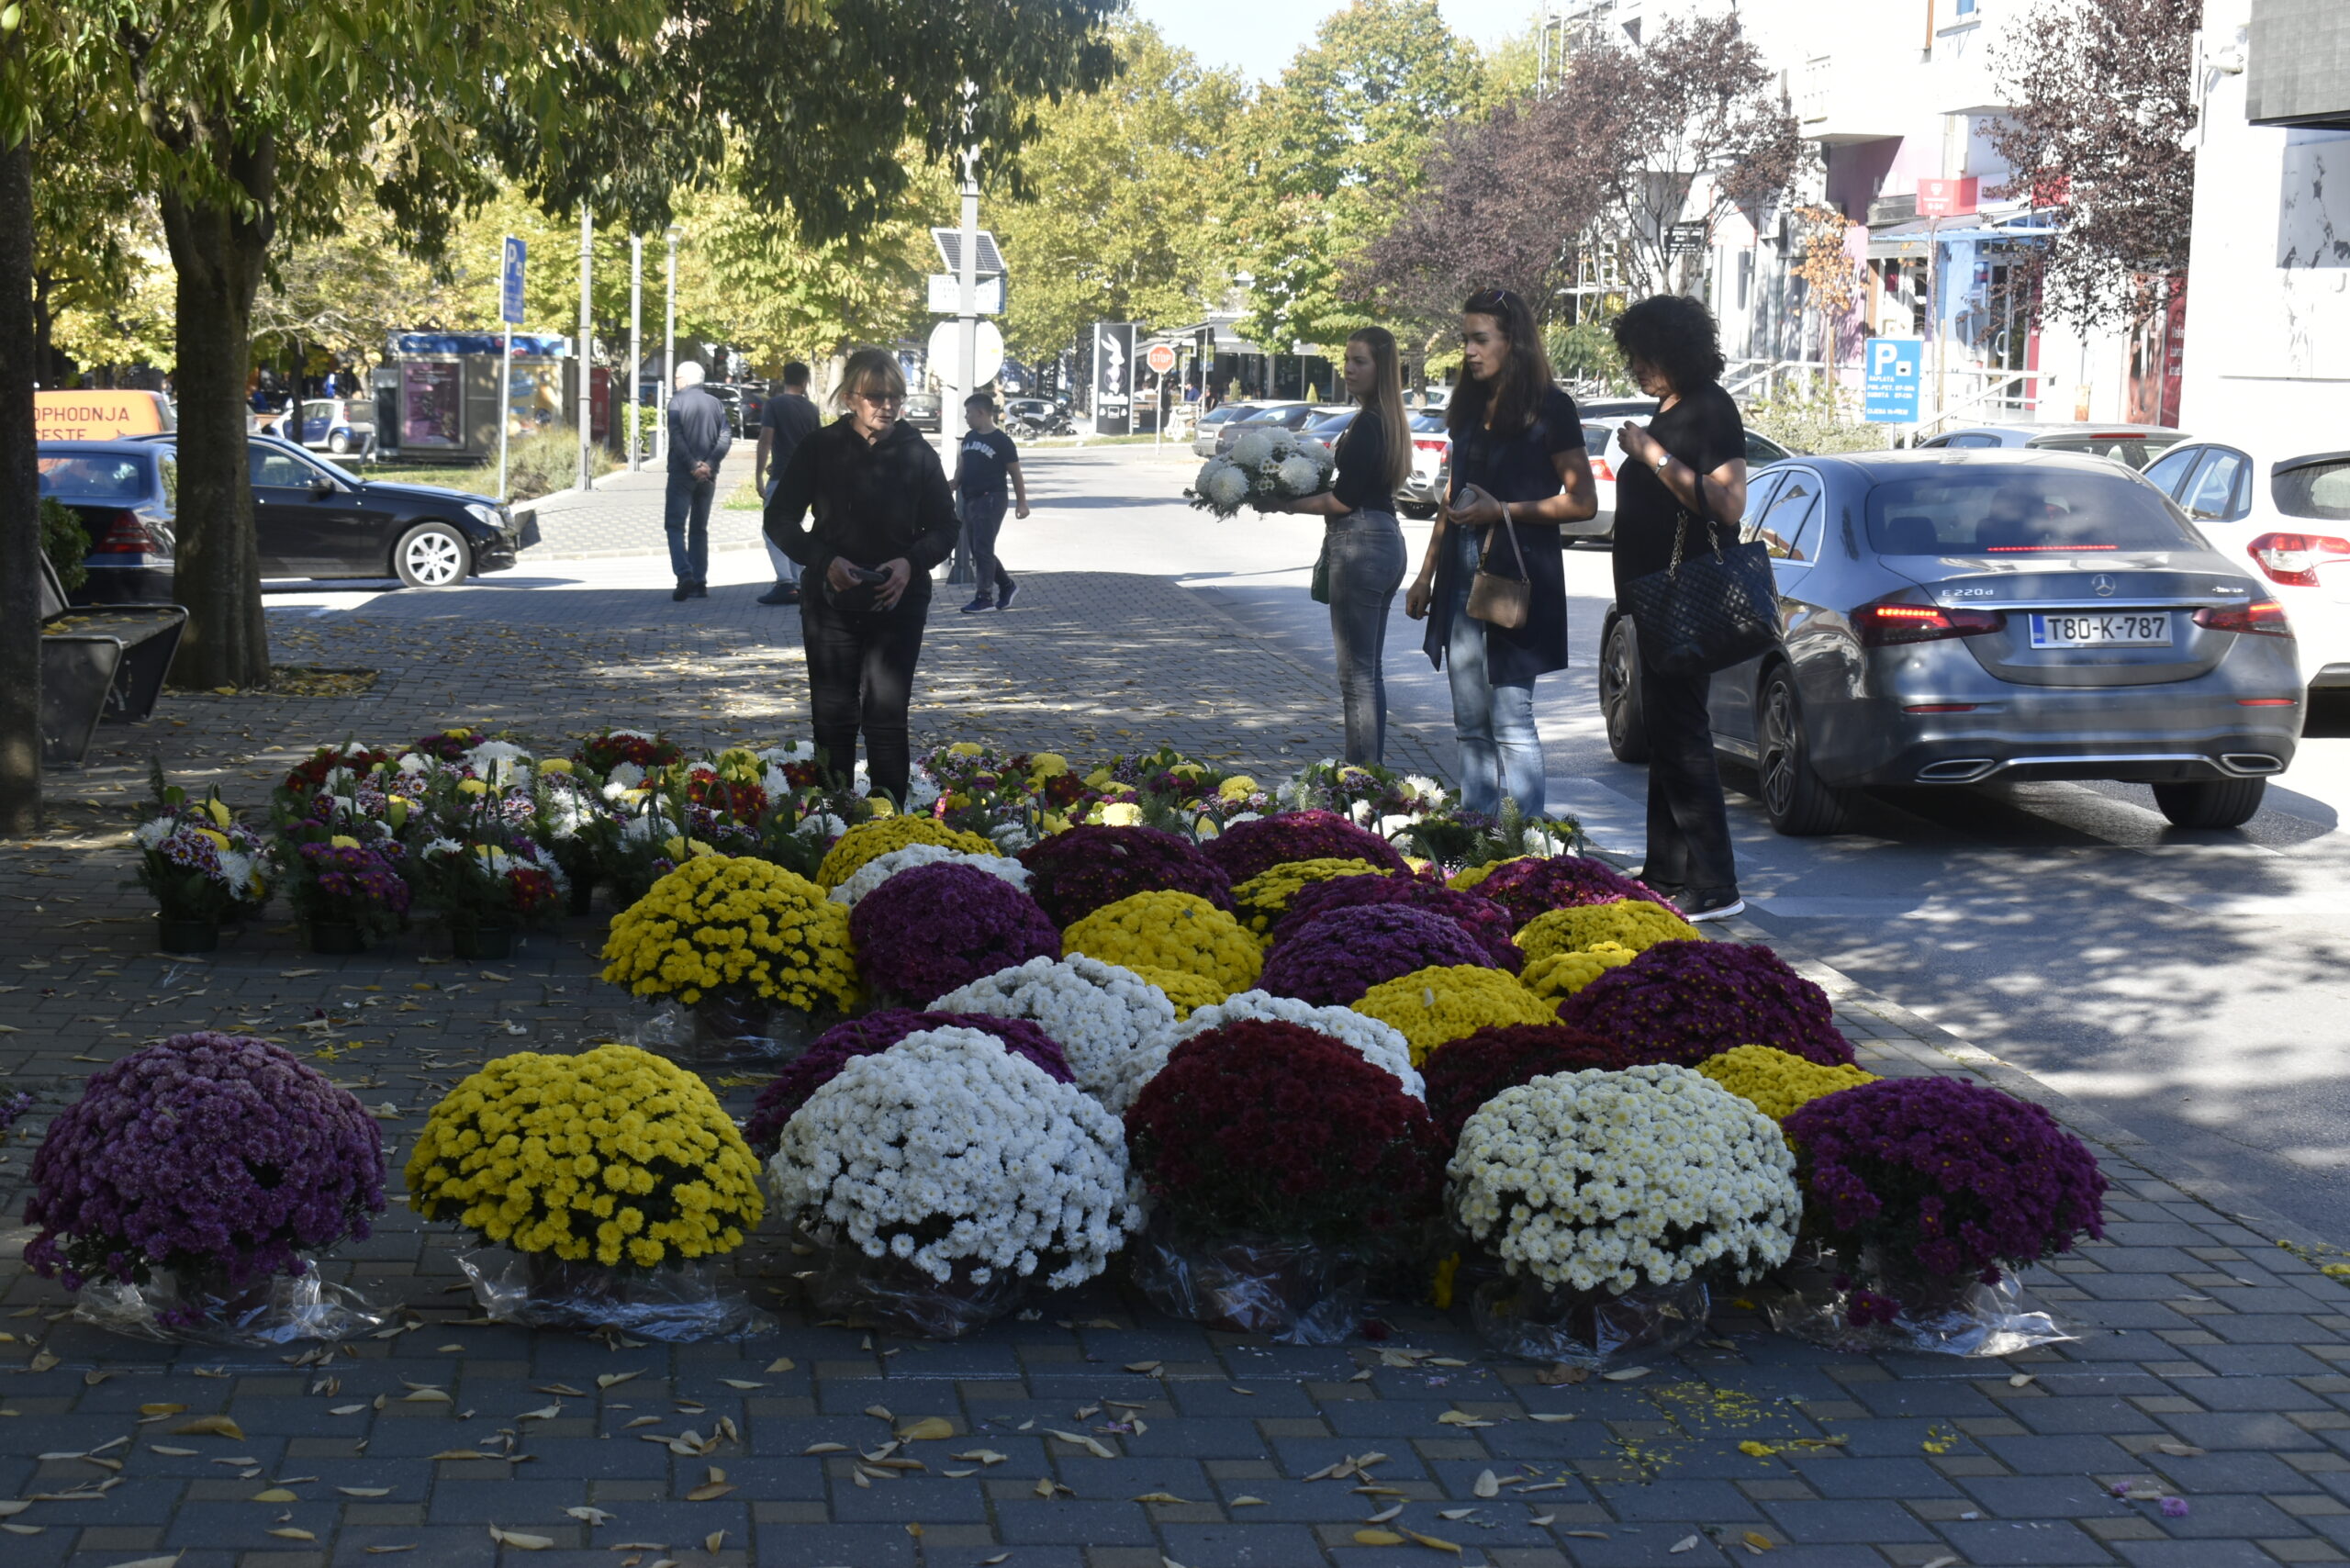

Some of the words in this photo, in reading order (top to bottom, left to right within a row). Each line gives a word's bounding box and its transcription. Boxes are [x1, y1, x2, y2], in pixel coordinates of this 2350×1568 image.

[1151, 353, 1171, 364] STOP
[1874, 343, 1897, 375] P
[1953, 588, 1994, 597] 220d
[2048, 617, 2165, 640] T80-K-787
